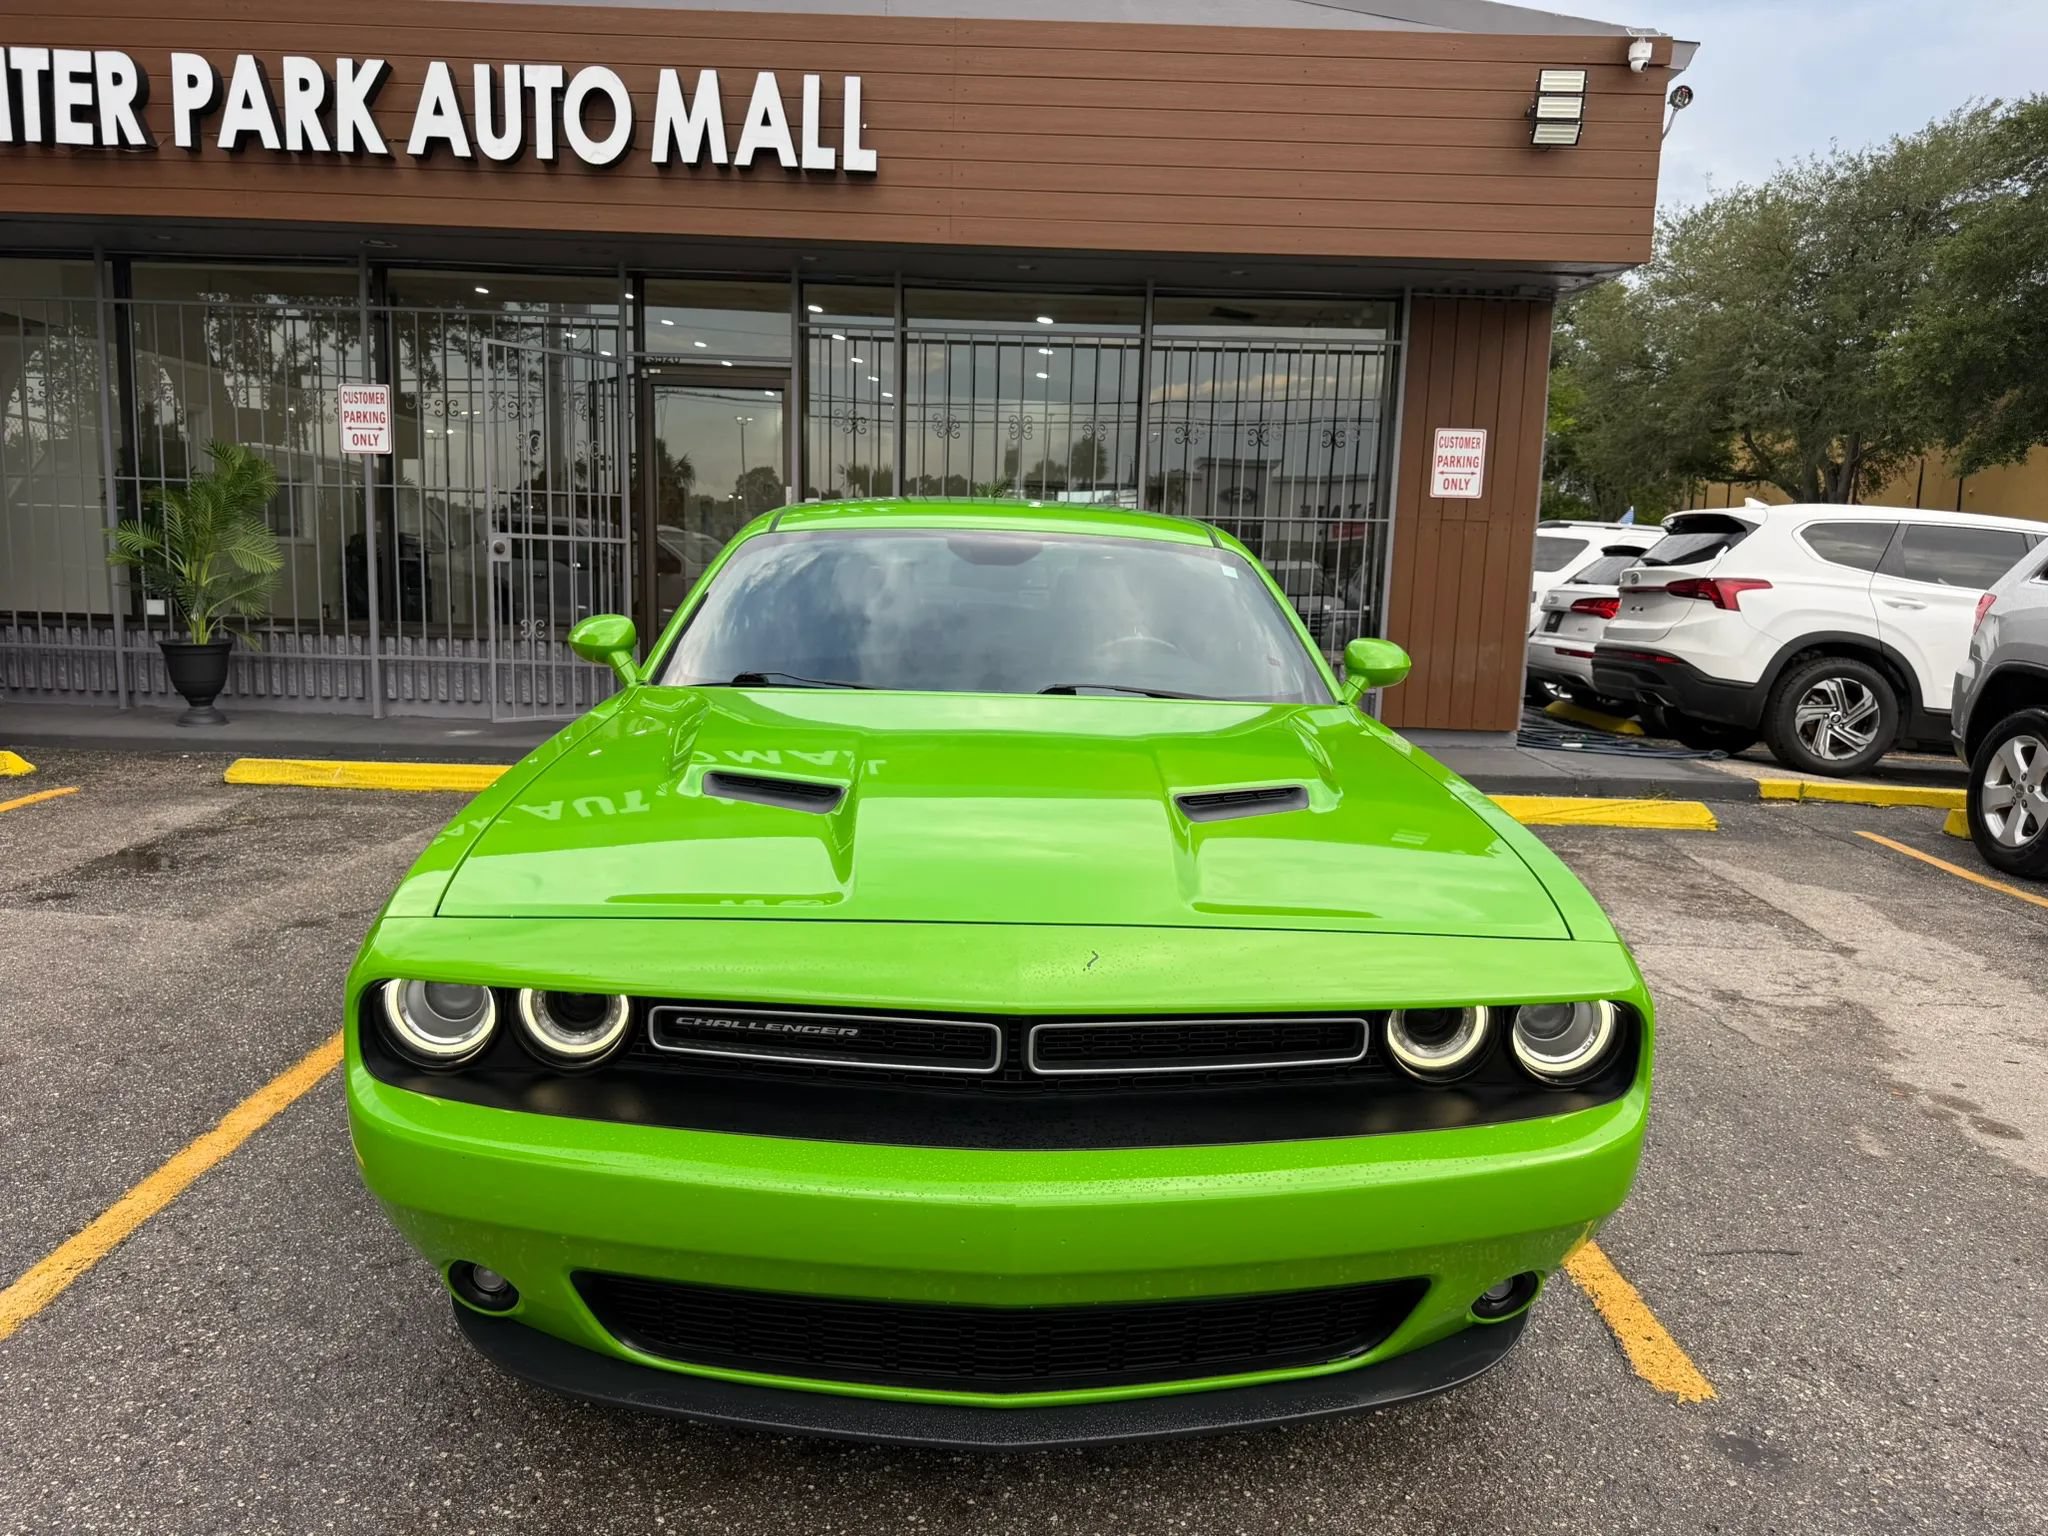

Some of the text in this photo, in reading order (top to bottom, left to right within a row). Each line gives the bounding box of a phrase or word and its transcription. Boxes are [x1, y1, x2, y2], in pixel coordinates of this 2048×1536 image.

[171, 52, 388, 155] PARK
[406, 61, 632, 165] AUTO
[651, 68, 878, 173] MALL
[342, 391, 385, 405] CUSTOMER
[343, 410, 386, 424] PARKING
[352, 433, 380, 447] ONLY
[1438, 435, 1481, 449] CUSTOMER
[1437, 455, 1480, 469] PARKING
[1442, 477, 1471, 491] ONLY
[675, 1016, 860, 1036] CHALLENGER
